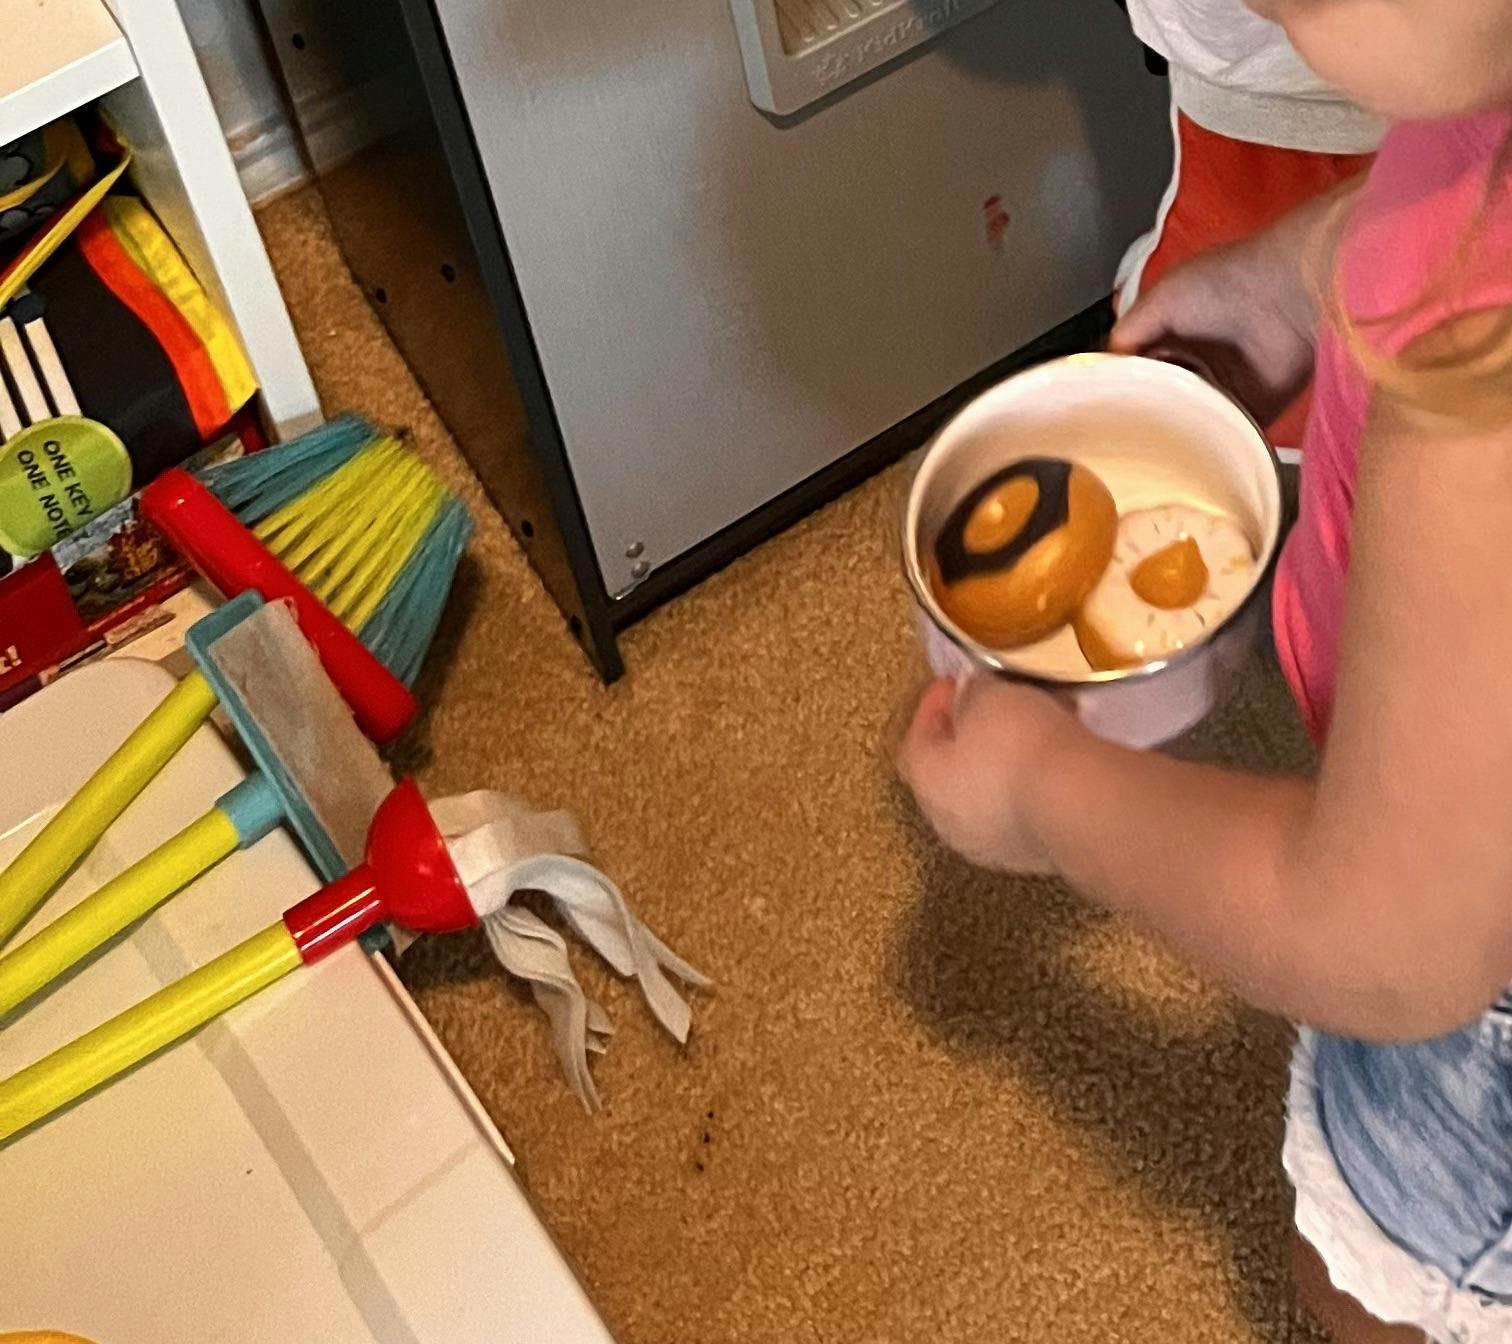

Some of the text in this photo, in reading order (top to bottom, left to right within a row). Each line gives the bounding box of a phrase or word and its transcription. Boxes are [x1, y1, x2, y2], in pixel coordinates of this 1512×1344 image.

[17, 450, 51, 490] ONE
[43, 440, 94, 516] ONE KEY
